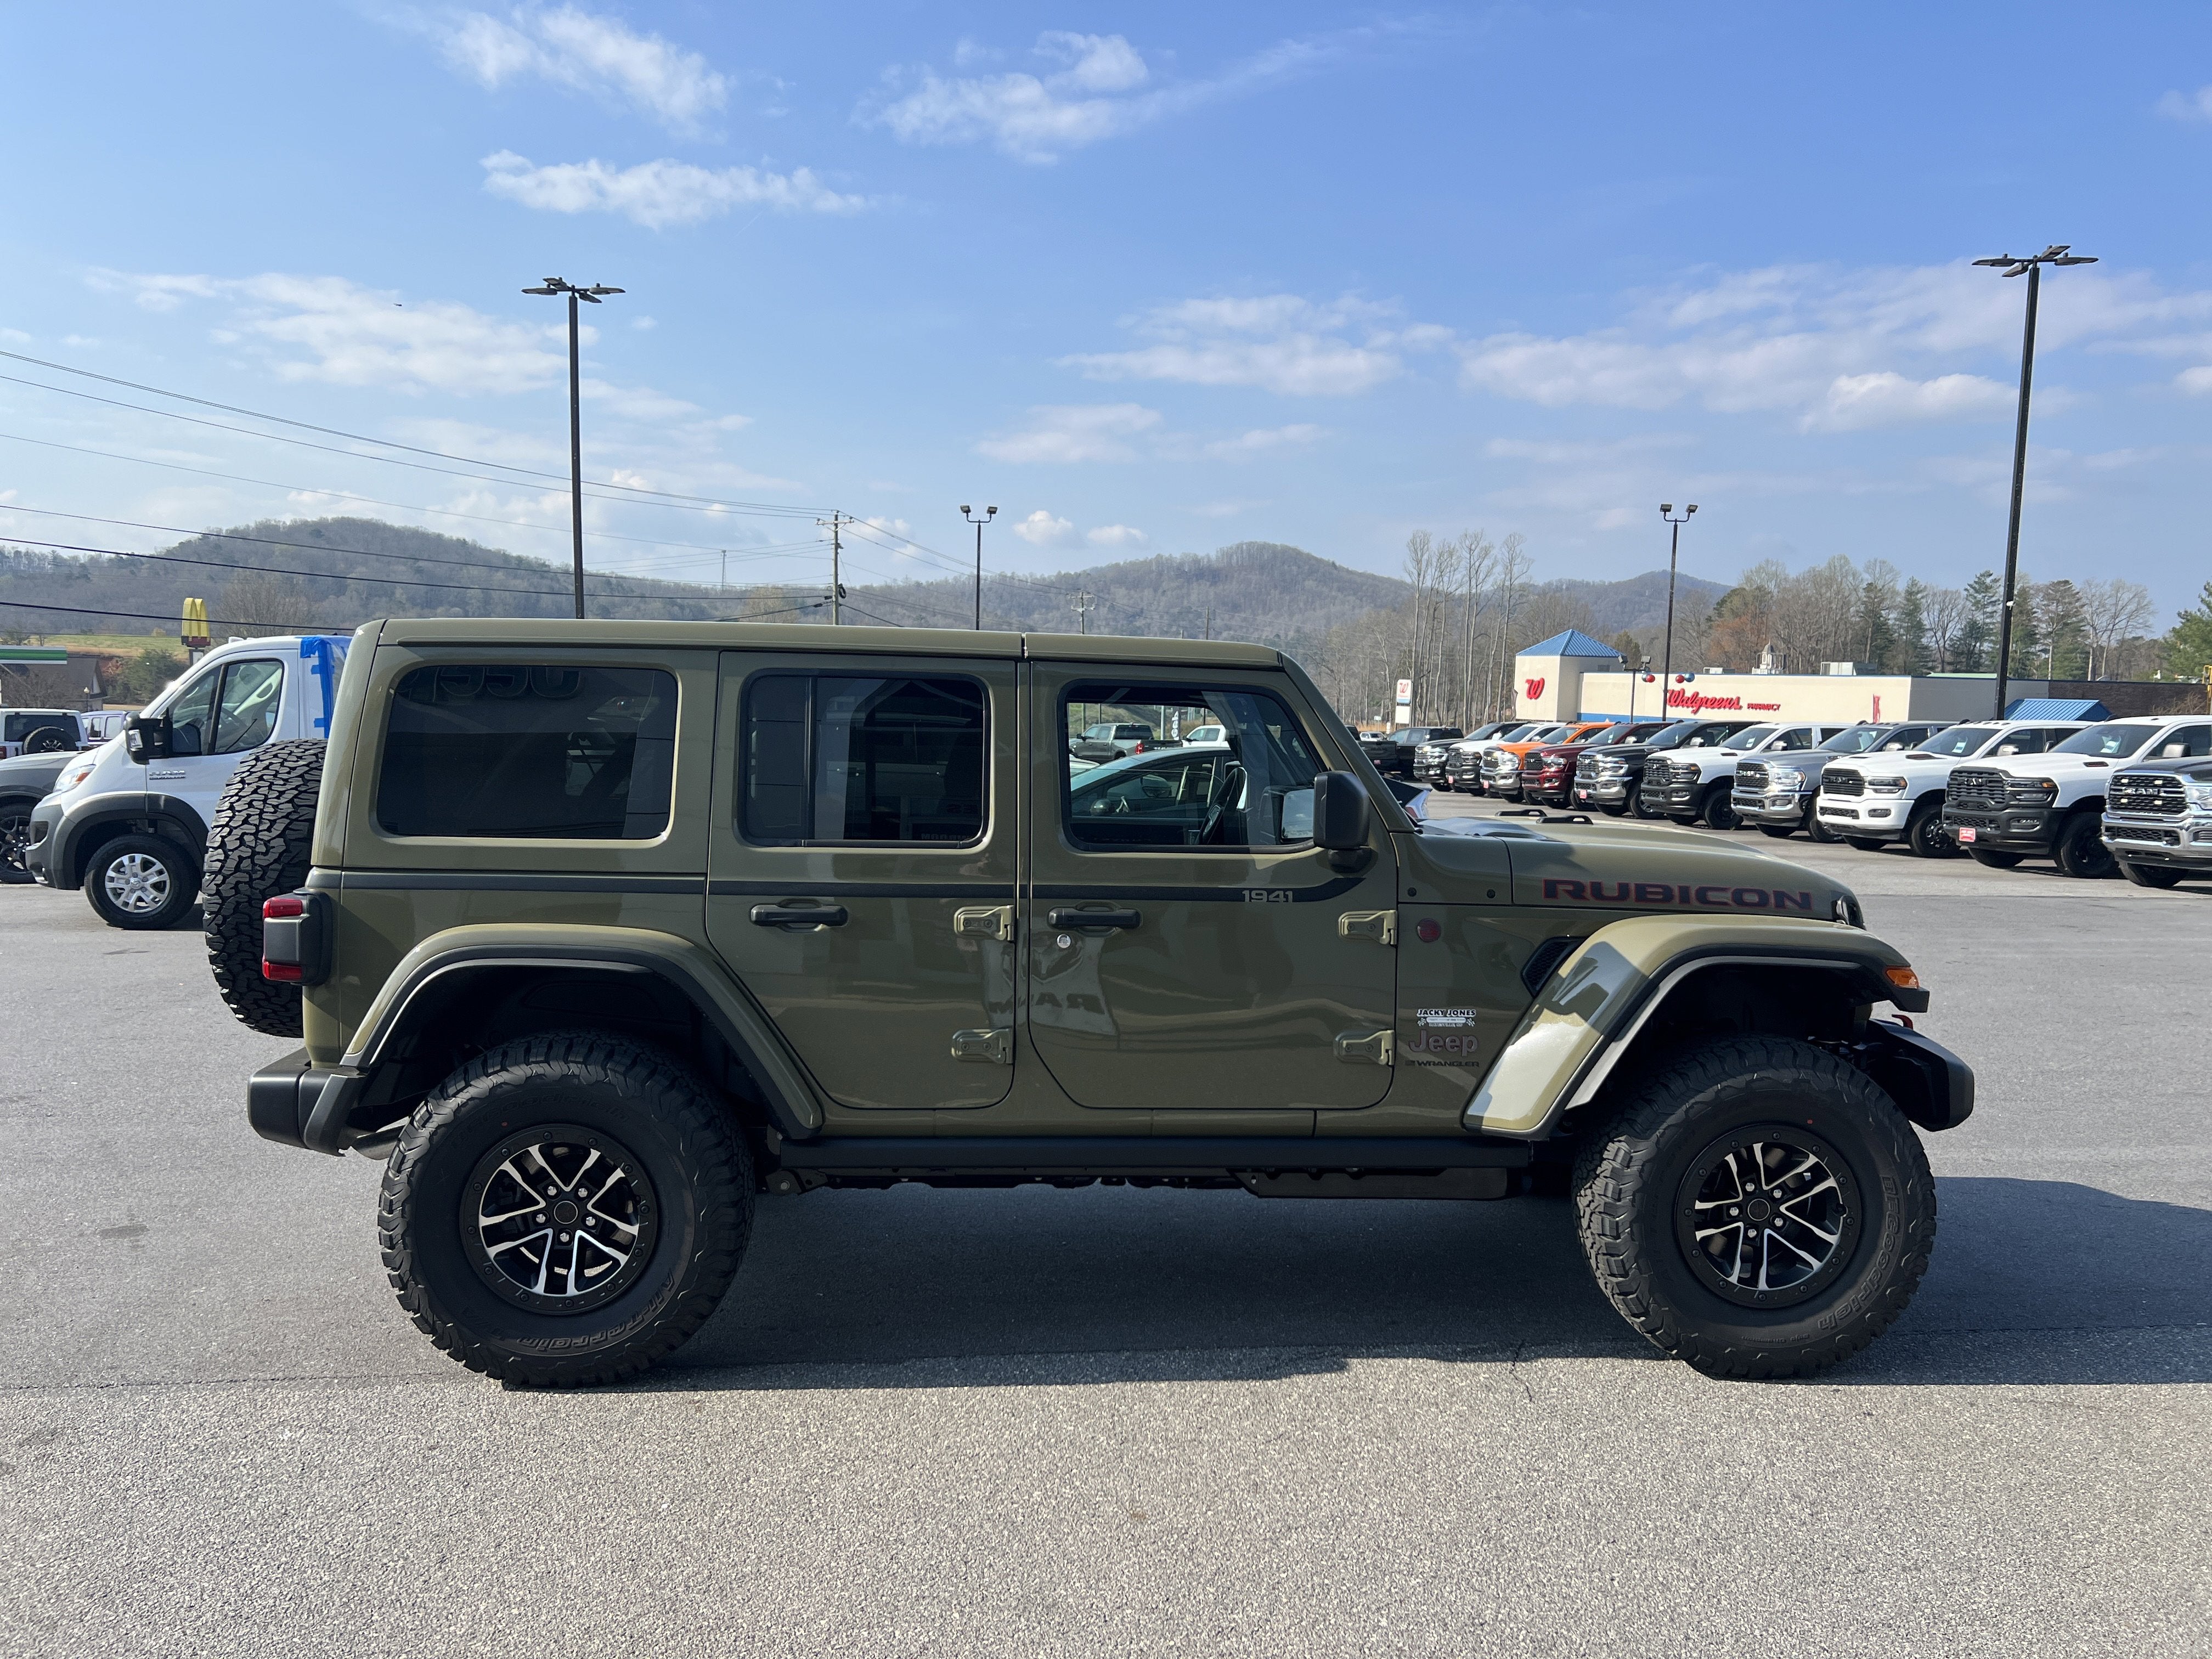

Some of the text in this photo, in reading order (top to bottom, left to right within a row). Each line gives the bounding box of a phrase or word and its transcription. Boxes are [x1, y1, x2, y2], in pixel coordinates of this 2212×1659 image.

[1525, 678, 1545, 699] W
[1666, 688, 1781, 715] Walgreens PHARMACY
[2123, 787, 2158, 795] RAM
[1242, 889, 1293, 903] 1941
[1543, 878, 1813, 911] RUBICON
[1408, 1029, 1479, 1057] Jeep
